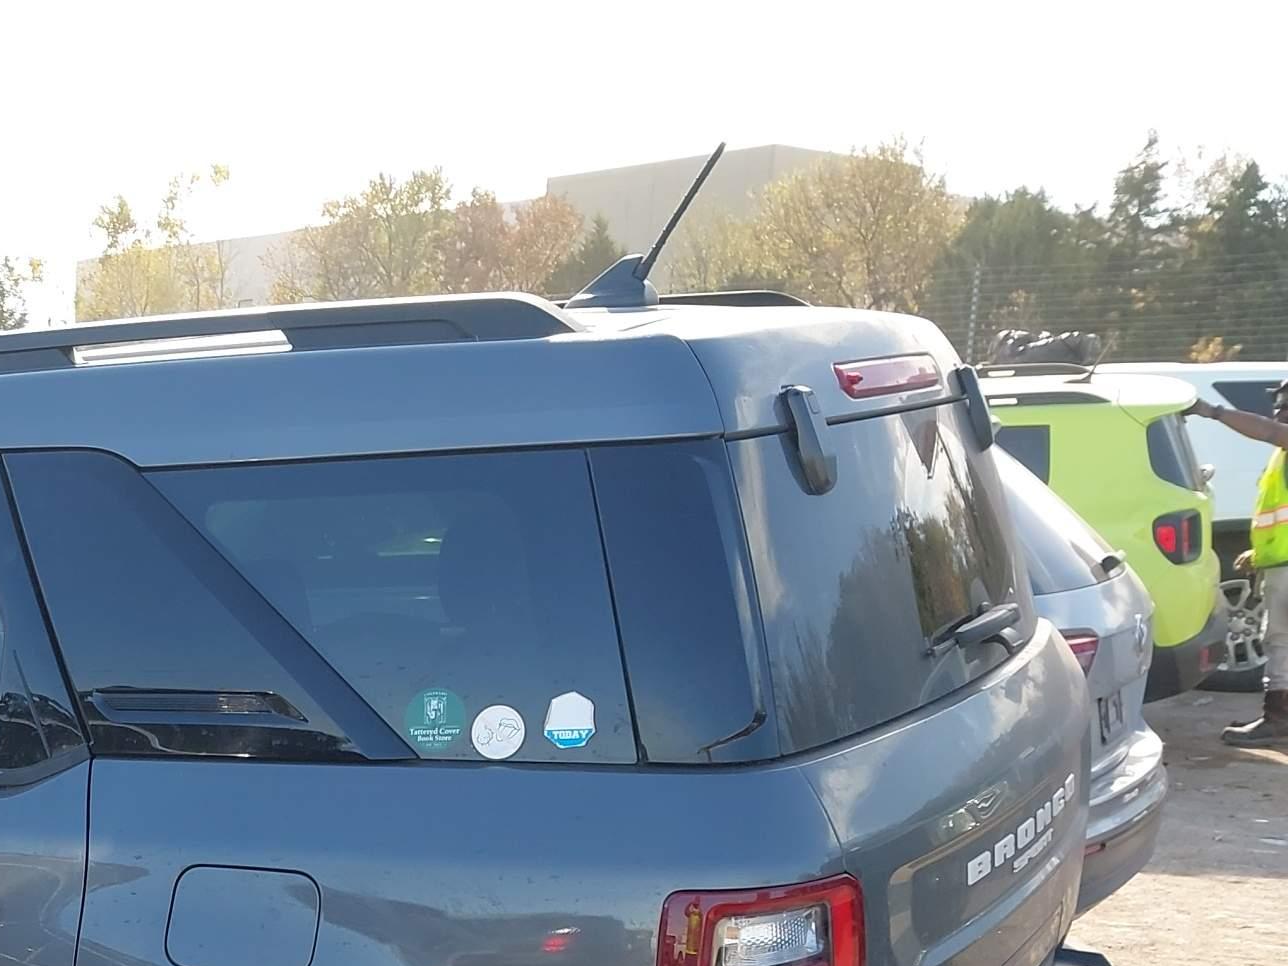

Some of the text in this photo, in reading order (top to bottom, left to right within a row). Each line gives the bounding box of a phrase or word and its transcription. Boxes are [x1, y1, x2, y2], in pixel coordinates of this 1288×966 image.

[409, 728, 438, 736] Tattered
[552, 729, 589, 740] TODAY
[967, 772, 1075, 886] BRONCO
